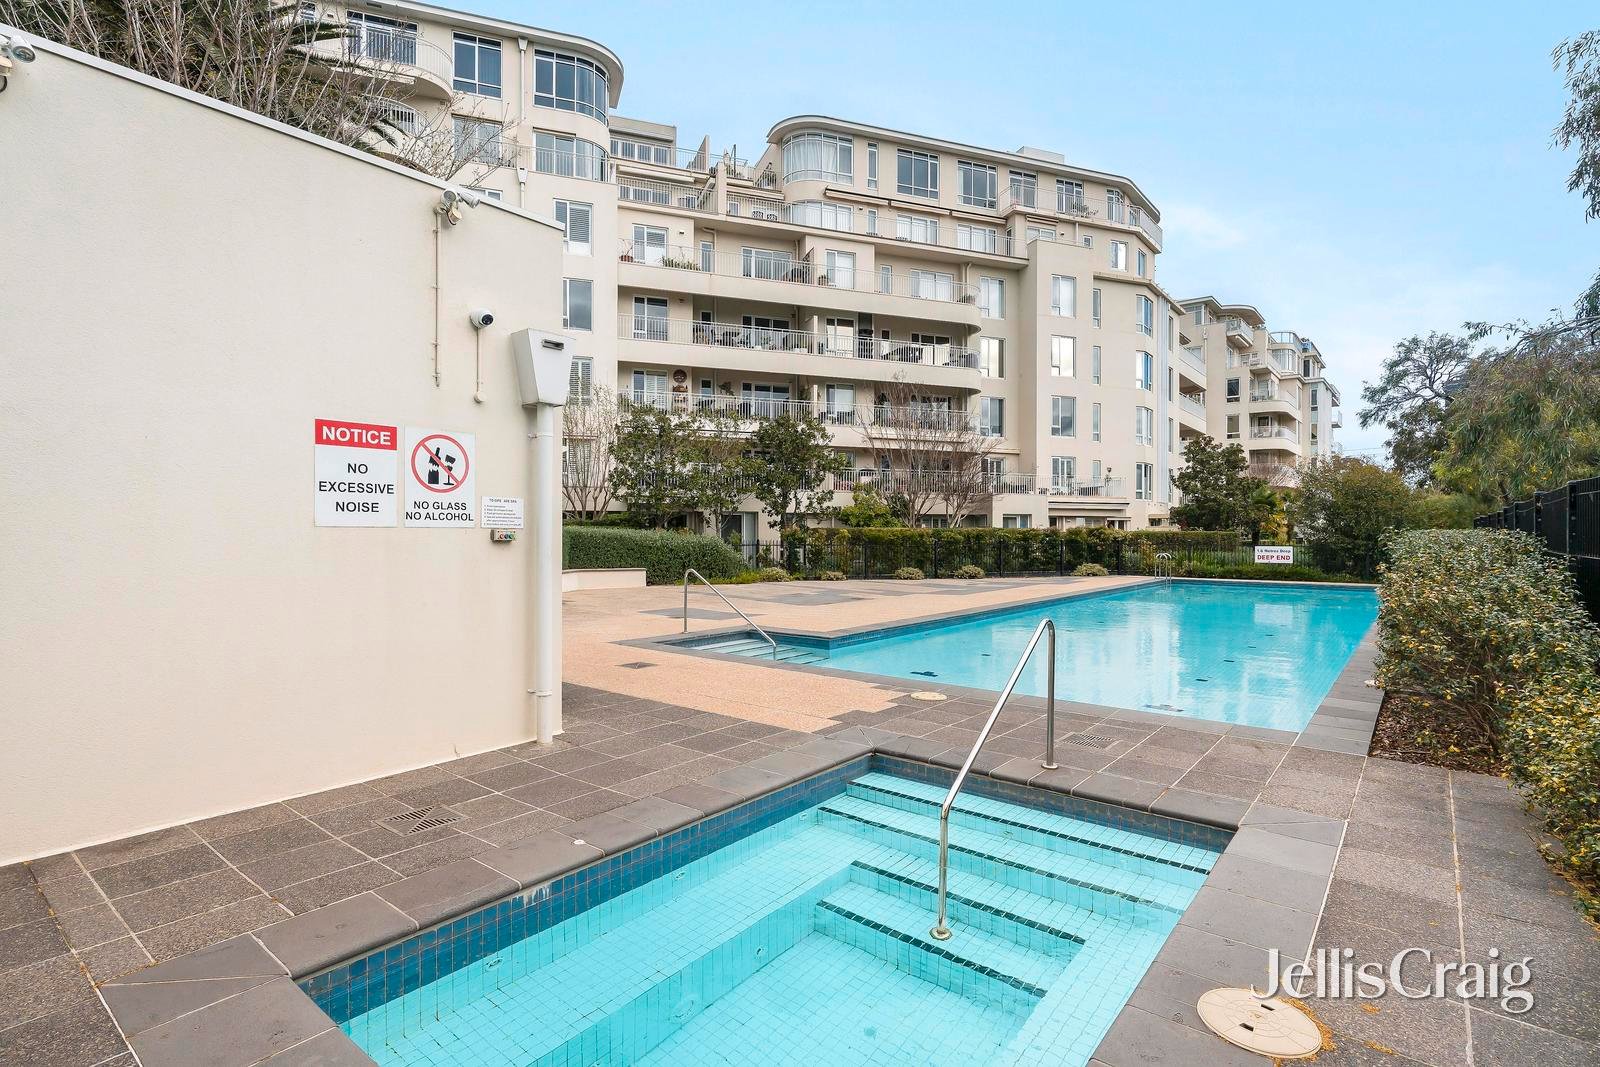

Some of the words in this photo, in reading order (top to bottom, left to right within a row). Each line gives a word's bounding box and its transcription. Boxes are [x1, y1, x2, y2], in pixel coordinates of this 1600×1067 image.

[322, 425, 391, 446] NOTICE
[347, 463, 369, 474] NO
[318, 481, 395, 494] EXCESSIVE
[335, 501, 380, 513] NOISE
[414, 501, 430, 510] NO
[432, 501, 467, 511] GLASS
[405, 512, 422, 520] NO
[424, 512, 474, 522] ALCOHOL
